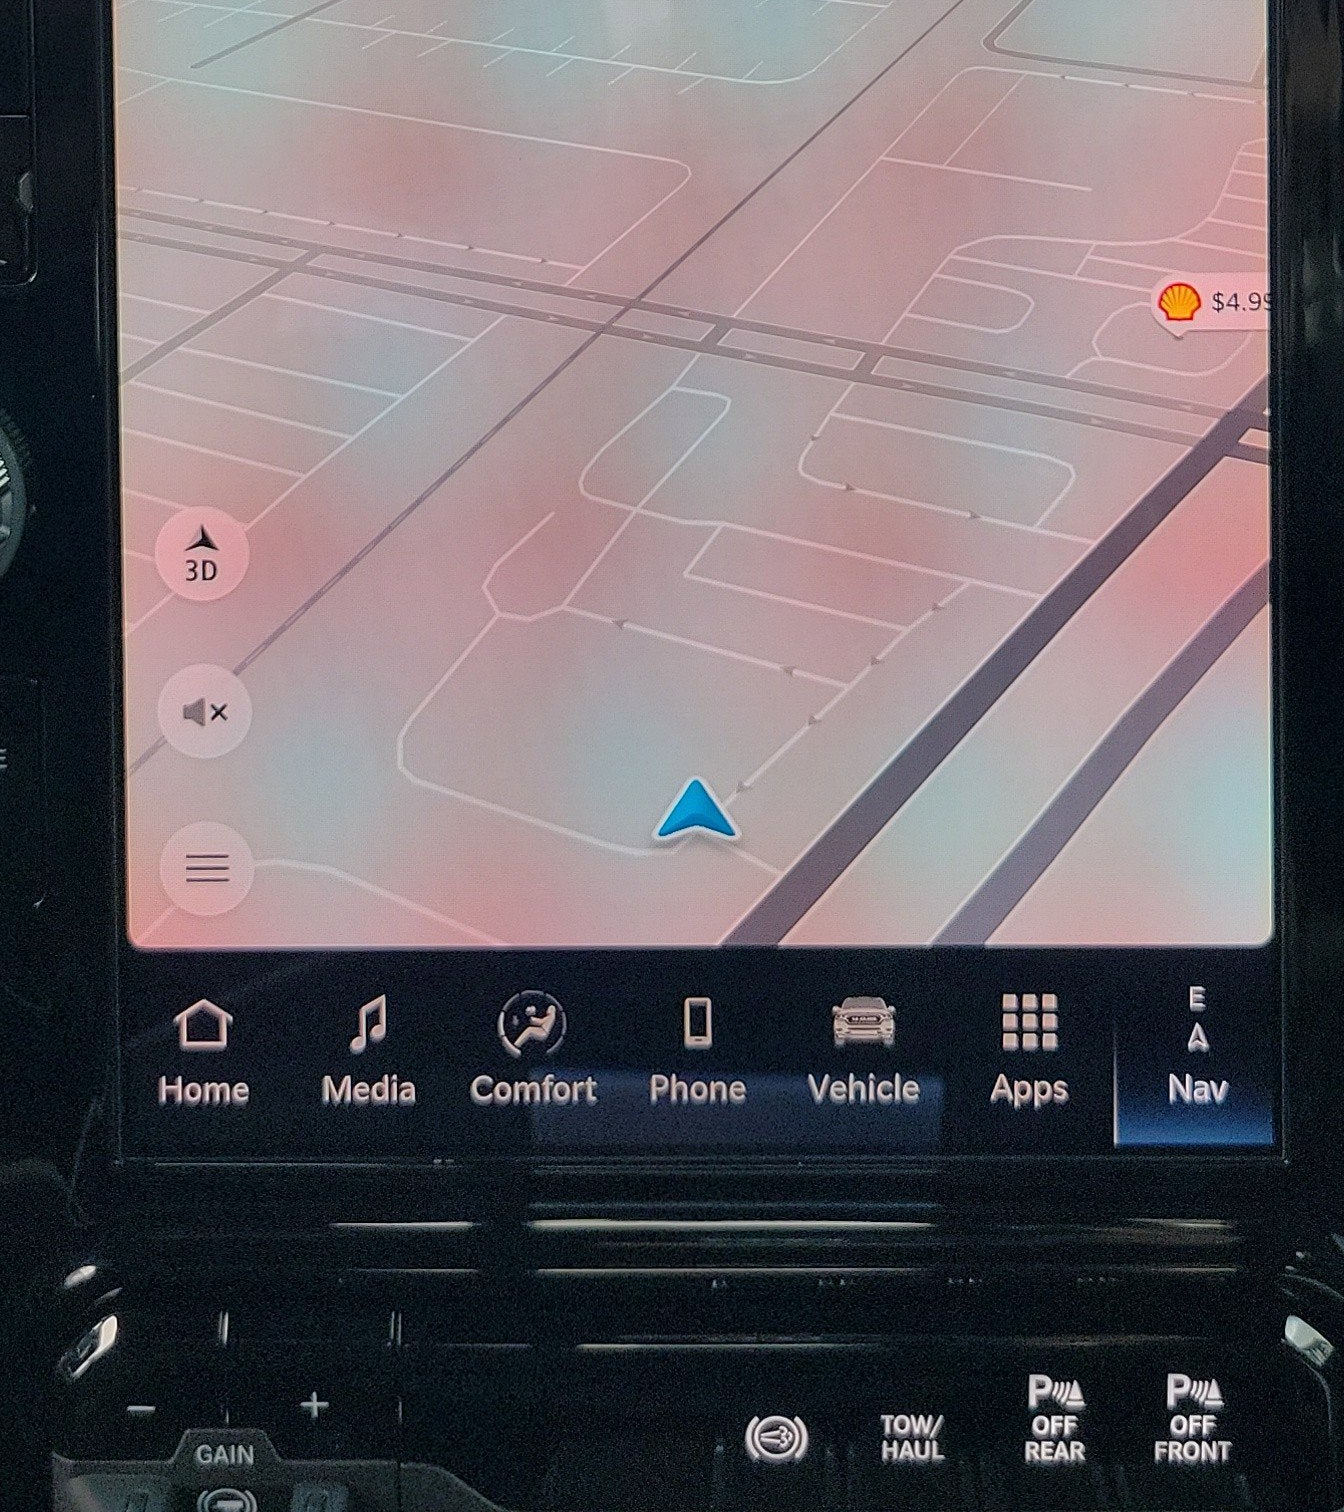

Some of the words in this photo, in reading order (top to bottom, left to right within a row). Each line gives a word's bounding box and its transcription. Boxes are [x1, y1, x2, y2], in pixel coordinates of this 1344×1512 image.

[185, 558, 218, 583] 3D
[1189, 986, 1207, 1011] E
[158, 1075, 250, 1106] Home
[321, 1074, 417, 1106] Media
[469, 1074, 598, 1105] Comfort
[649, 1073, 748, 1105] Phone
[807, 1073, 920, 1105] Vehicle
[990, 1073, 1070, 1110] Apps
[1169, 1072, 1230, 1105] Nav
[881, 1414, 945, 1438] TOW/
[1031, 1415, 1078, 1438] OFF
[1169, 1415, 1217, 1438] OFF
[196, 1444, 255, 1466] GAIN
[881, 1439, 945, 1462] HAUL
[1025, 1440, 1086, 1462] REAR
[1155, 1440, 1233, 1463] FRONT
